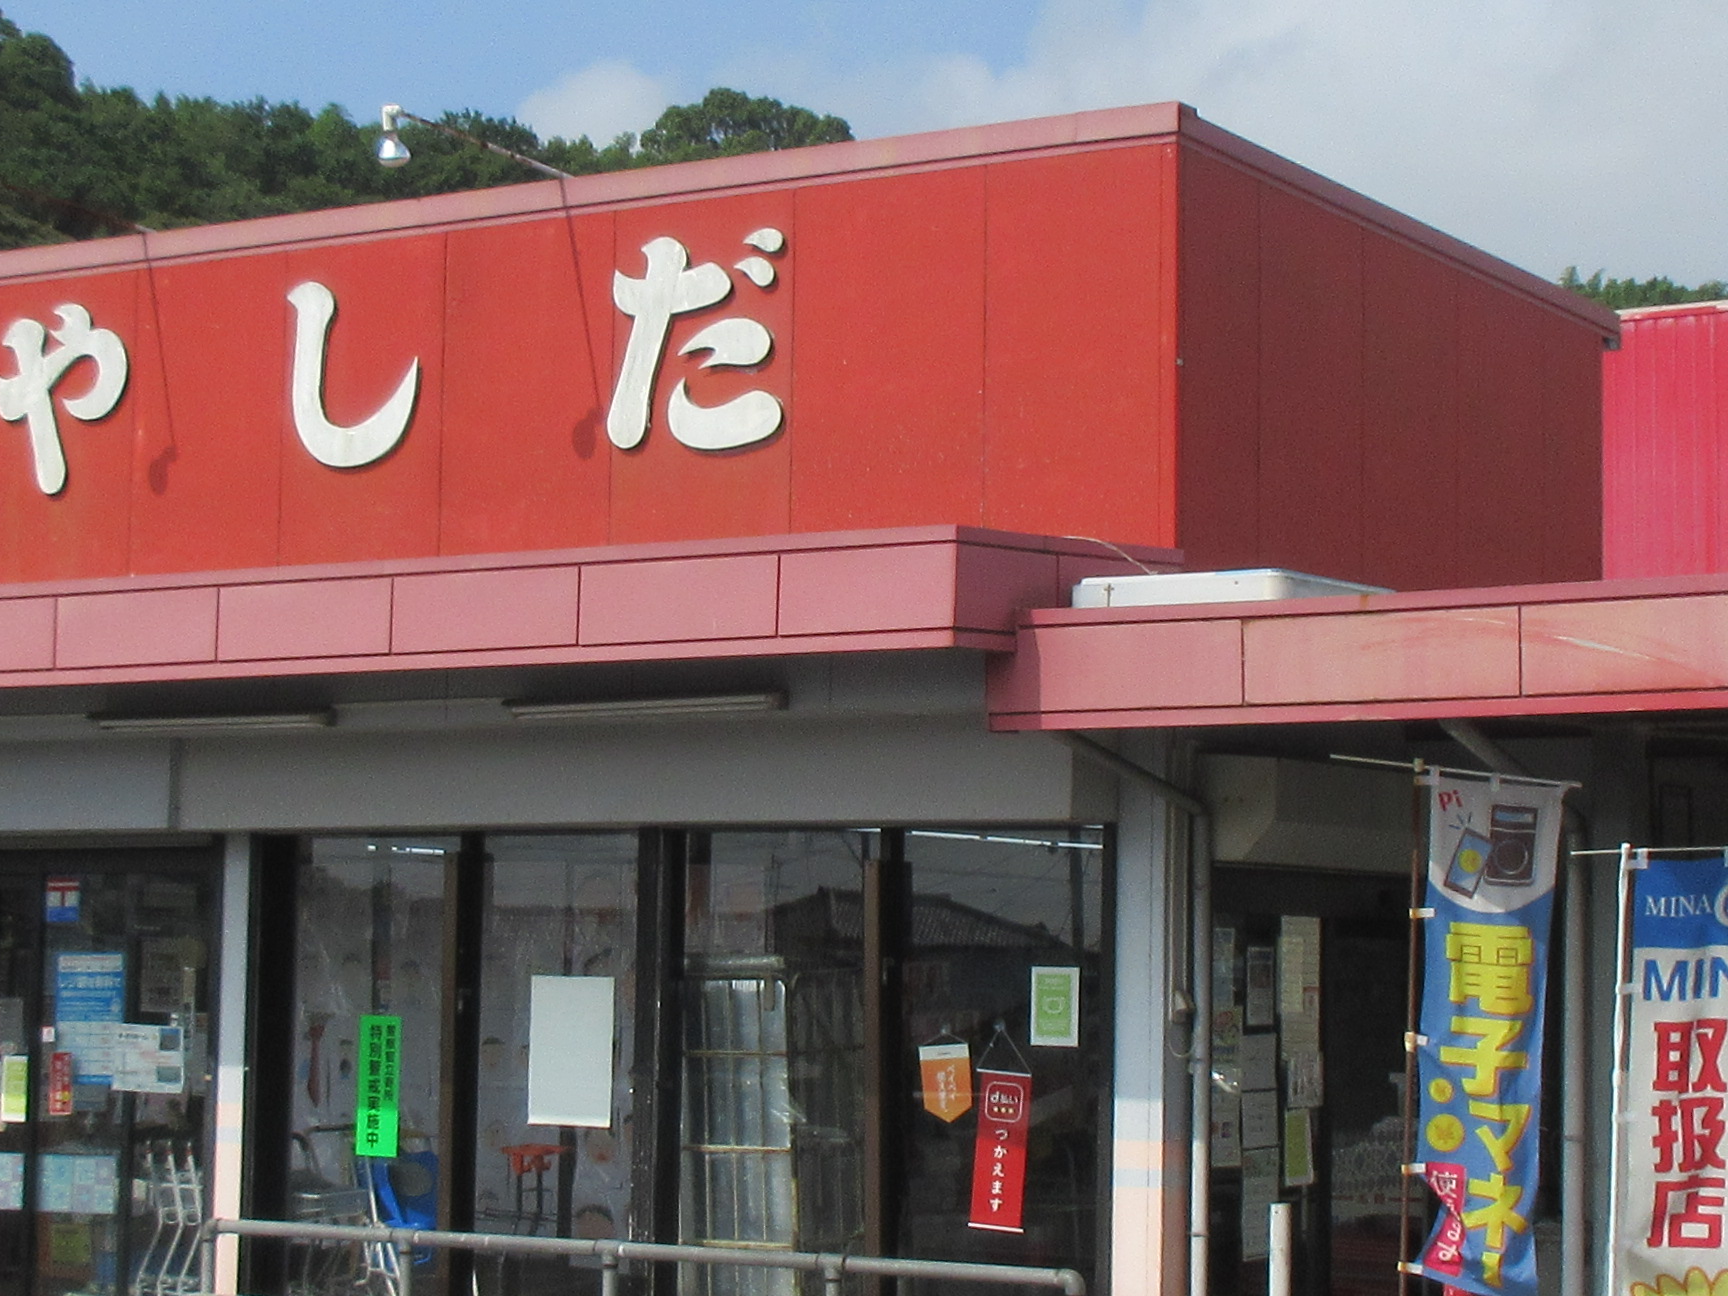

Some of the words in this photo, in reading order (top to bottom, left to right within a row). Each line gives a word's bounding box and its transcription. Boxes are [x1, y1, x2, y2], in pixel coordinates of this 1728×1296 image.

[989, 1128, 1008, 1213] つかえます
[990, 1091, 1020, 1105] d払い
[1440, 921, 1534, 1288] 電子マネー
[1646, 1018, 1728, 1248] 取扱店
